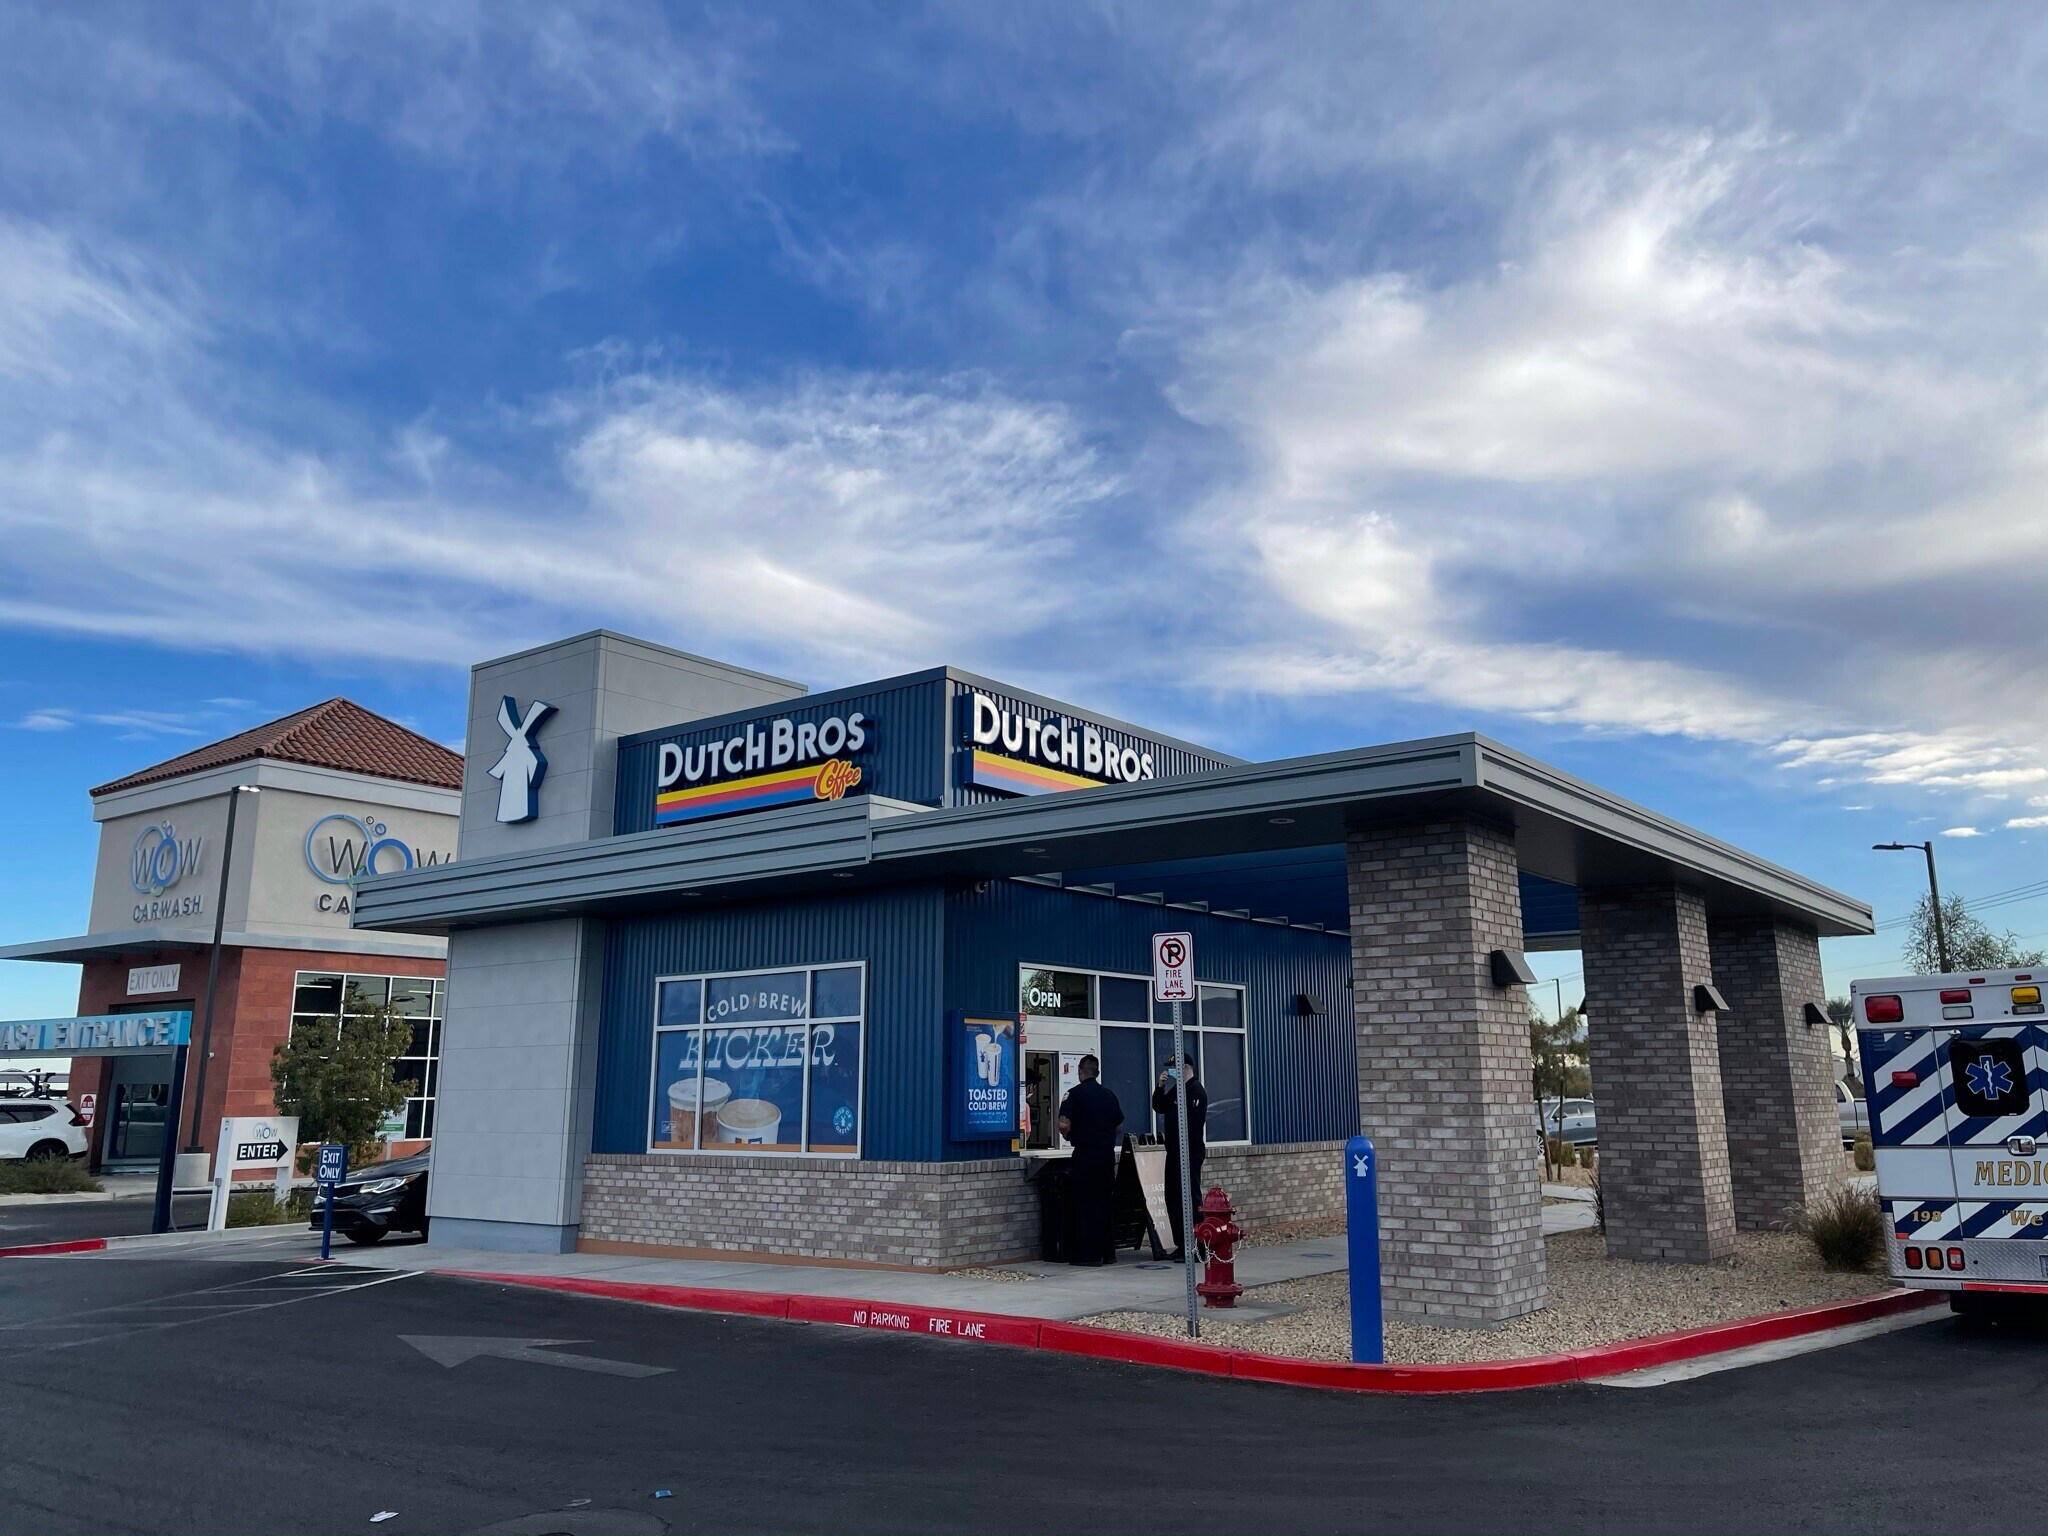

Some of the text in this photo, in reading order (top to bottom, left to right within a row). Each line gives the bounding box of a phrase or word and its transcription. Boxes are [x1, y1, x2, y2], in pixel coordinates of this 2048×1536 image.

[974, 692, 1155, 783] DUTCH BROS
[658, 712, 866, 787] DUTCH BROS
[814, 760, 861, 799] Coffee
[134, 837, 202, 888] WOW
[133, 895, 204, 922] CARWASH
[129, 968, 177, 990] EXIT ONLY
[1164, 979, 1184, 988] LANE
[1165, 969, 1182, 978] FIRE
[706, 991, 807, 1022] COLD BREW
[1029, 987, 1061, 1008] OPEN
[0, 1018, 172, 1050] ASH ENTRANCE
[968, 1089, 1008, 1101] TOASTED
[968, 1101, 1008, 1111] COLD BREW
[239, 1144, 279, 1158] ENTER
[322, 1149, 340, 1164] EXIT
[319, 1164, 341, 1179] ONLY
[1912, 1210, 1942, 1223] 198
[853, 1310, 986, 1339] NO PARKING FIRE LANE
